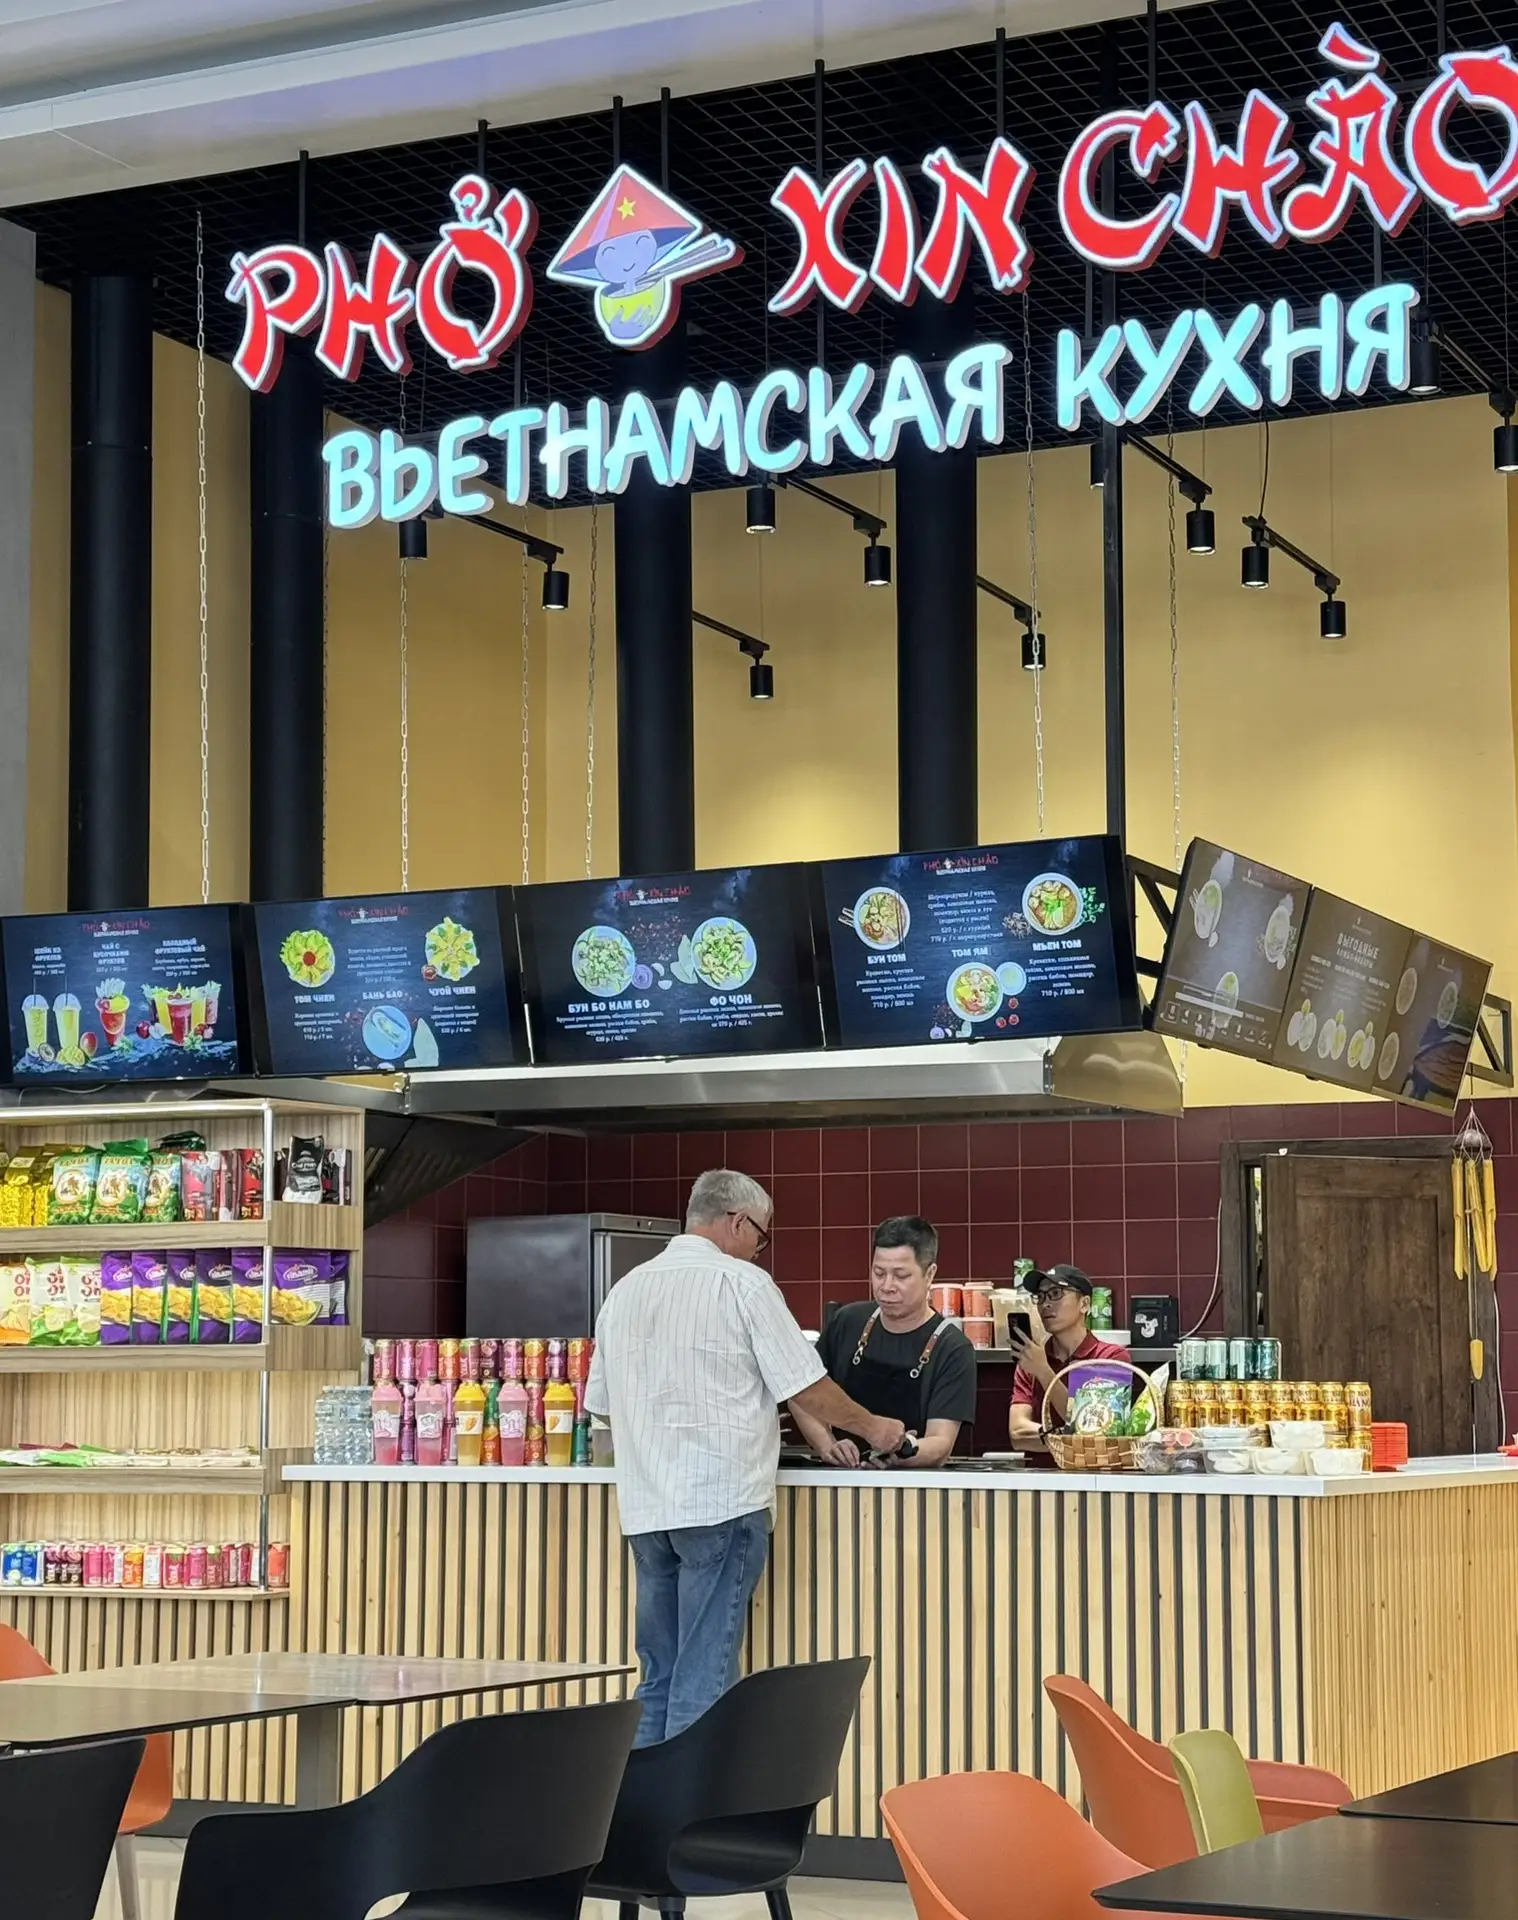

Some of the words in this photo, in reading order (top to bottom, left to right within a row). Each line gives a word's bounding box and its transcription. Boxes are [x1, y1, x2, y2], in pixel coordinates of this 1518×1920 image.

[225, 174, 534, 391] PHỞ
[768, 137, 1032, 313] XIN
[1058, 22, 1518, 269] CHÀO
[322, 343, 1010, 528] ВЬЕТНАМСКАЯ
[1057, 283, 1419, 431] КУХНЯ
[1061, 938, 1082, 949] ТОМ
[951, 948, 971, 958] ТОМ
[568, 1003, 589, 1013] БУН
[591, 1002, 606, 1012] БО
[634, 999, 650, 1009] БО
[709, 995, 727, 1006] ФО
[728, 994, 753, 1005] ЧОН
